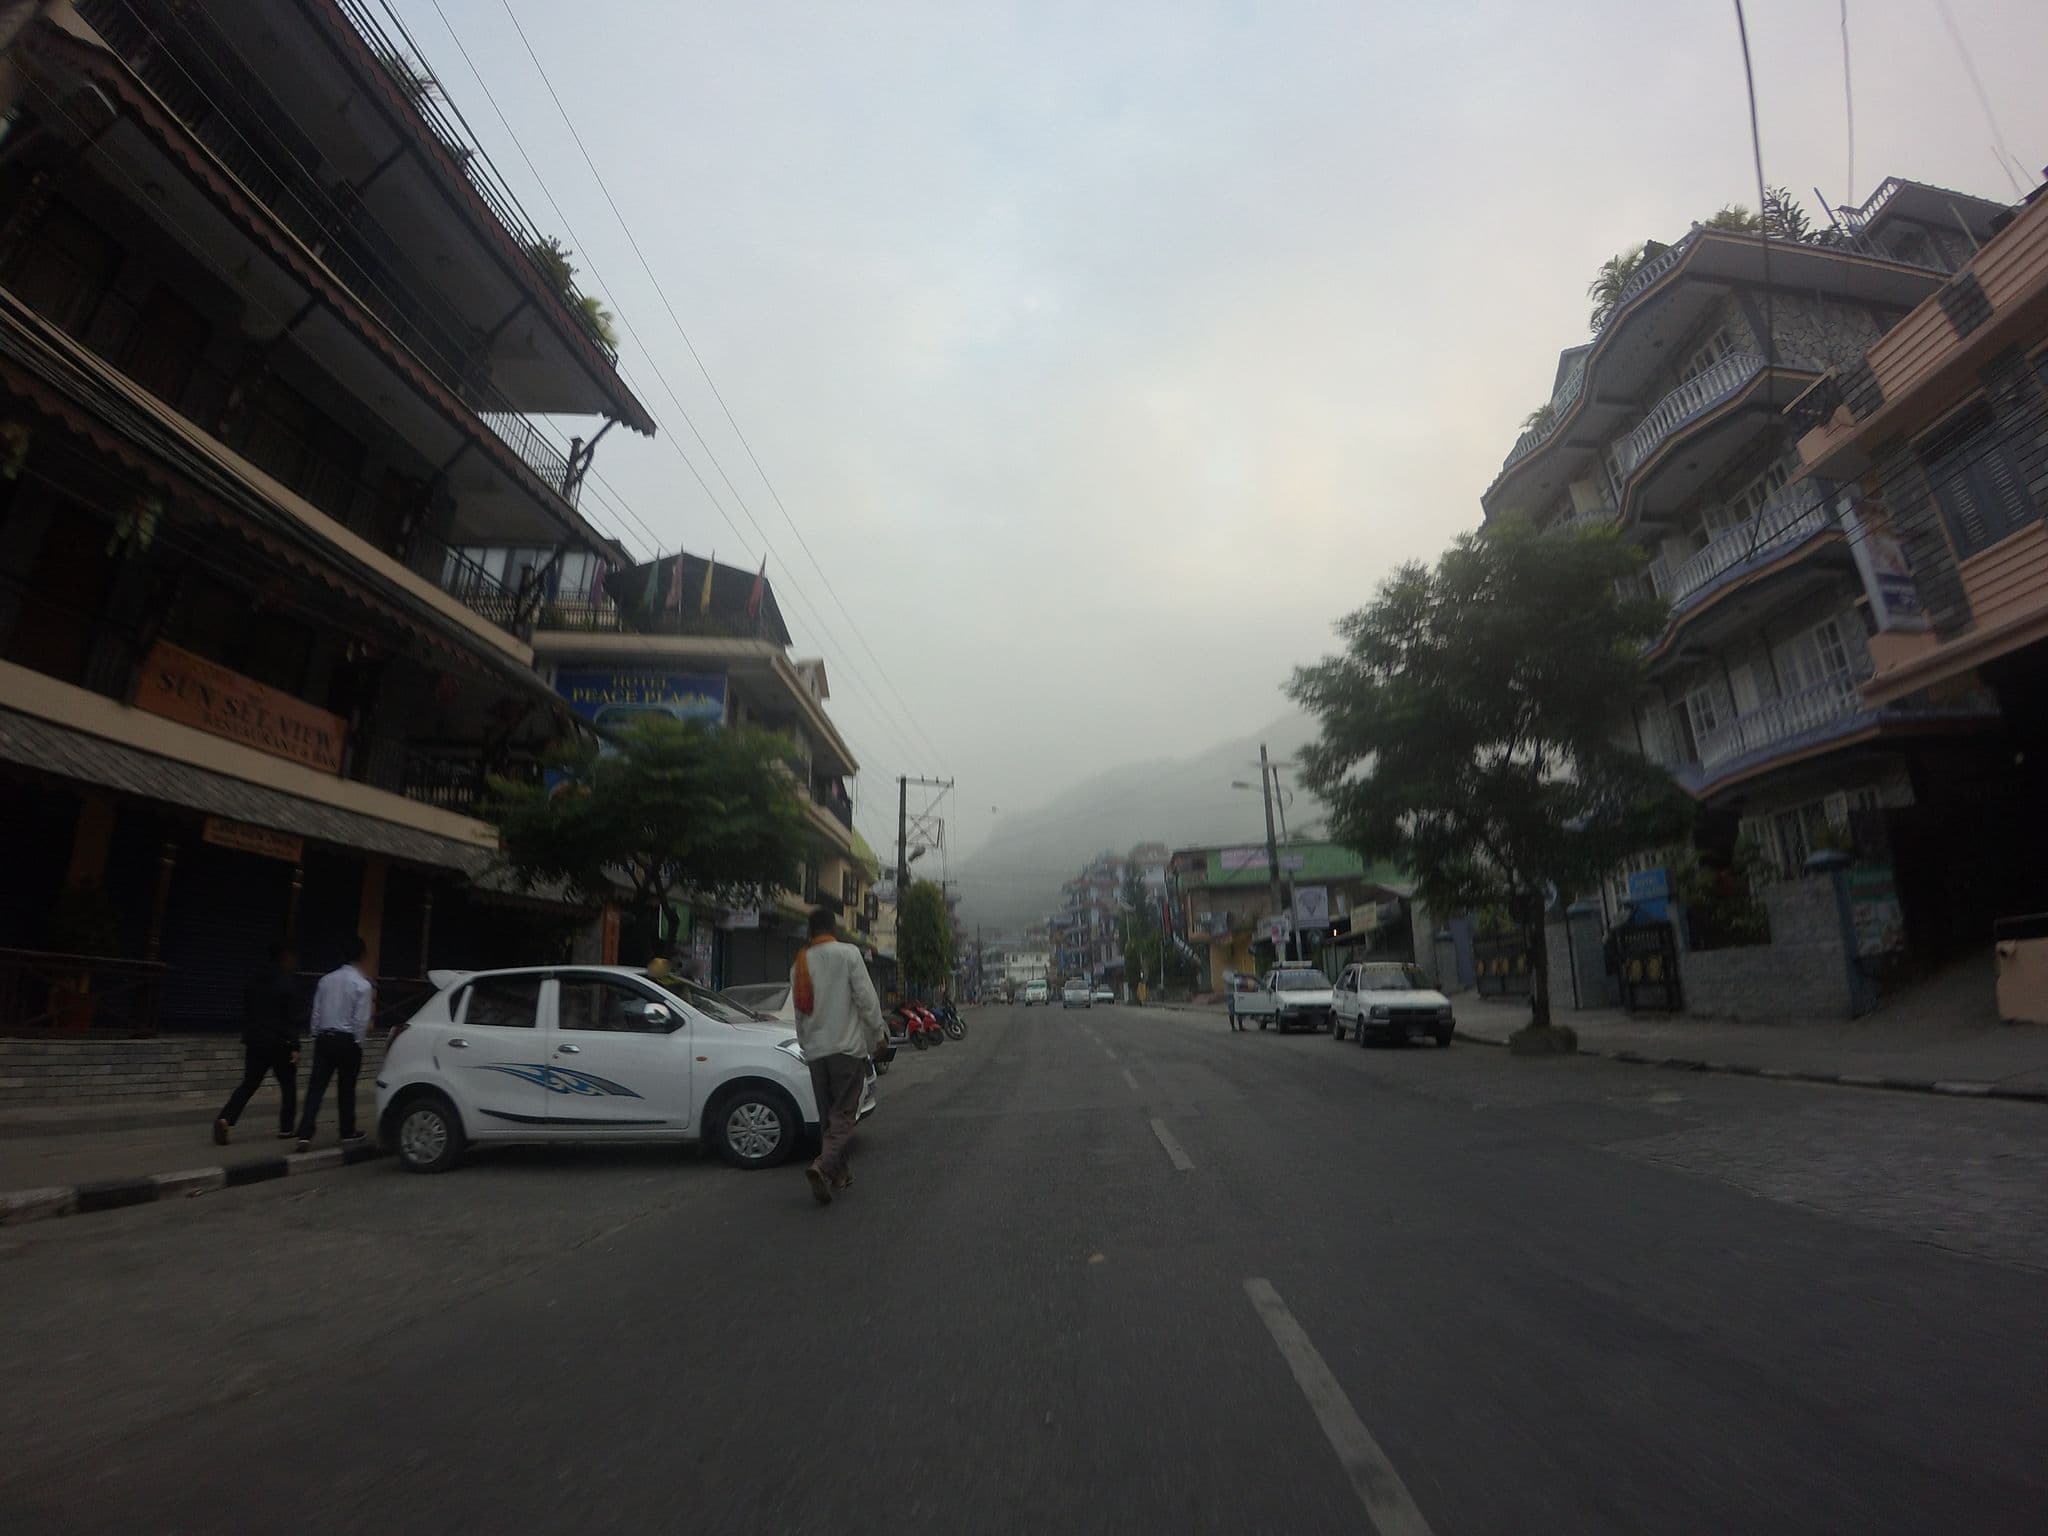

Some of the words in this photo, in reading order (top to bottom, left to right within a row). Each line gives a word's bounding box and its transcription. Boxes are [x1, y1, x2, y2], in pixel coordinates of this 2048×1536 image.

[611, 673, 667, 688] HOTEL
[572, 687, 637, 703] PEACE
[158, 672, 218, 708] SUN
[224, 697, 269, 729] SET
[273, 714, 333, 749] VIEW
